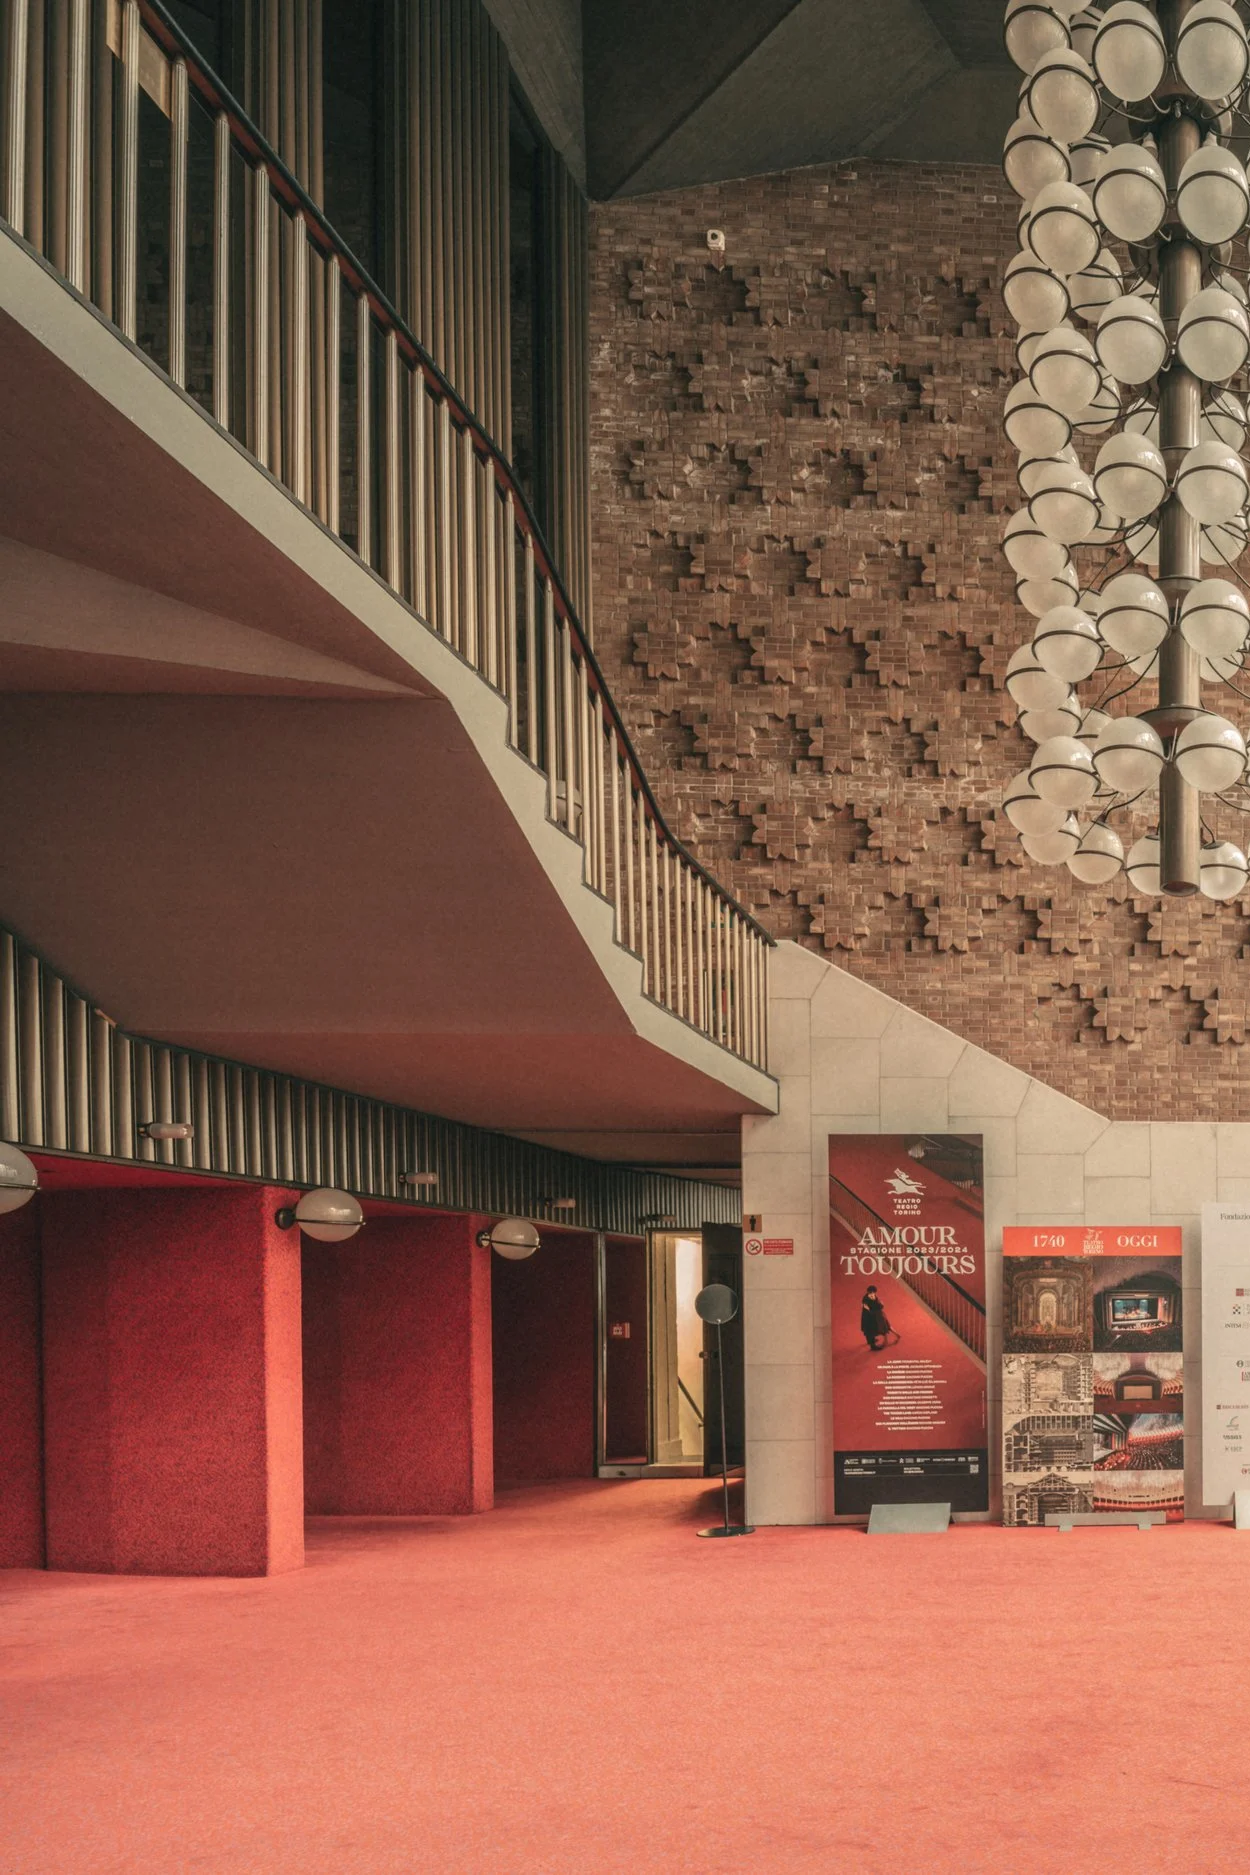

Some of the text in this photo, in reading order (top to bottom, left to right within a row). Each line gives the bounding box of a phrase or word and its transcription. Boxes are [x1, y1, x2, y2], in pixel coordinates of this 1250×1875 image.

[858, 1226, 957, 1246] AMOUR
[1032, 1234, 1158, 1248] 1740 OGGI
[840, 1255, 975, 1279] TOUJOURS
